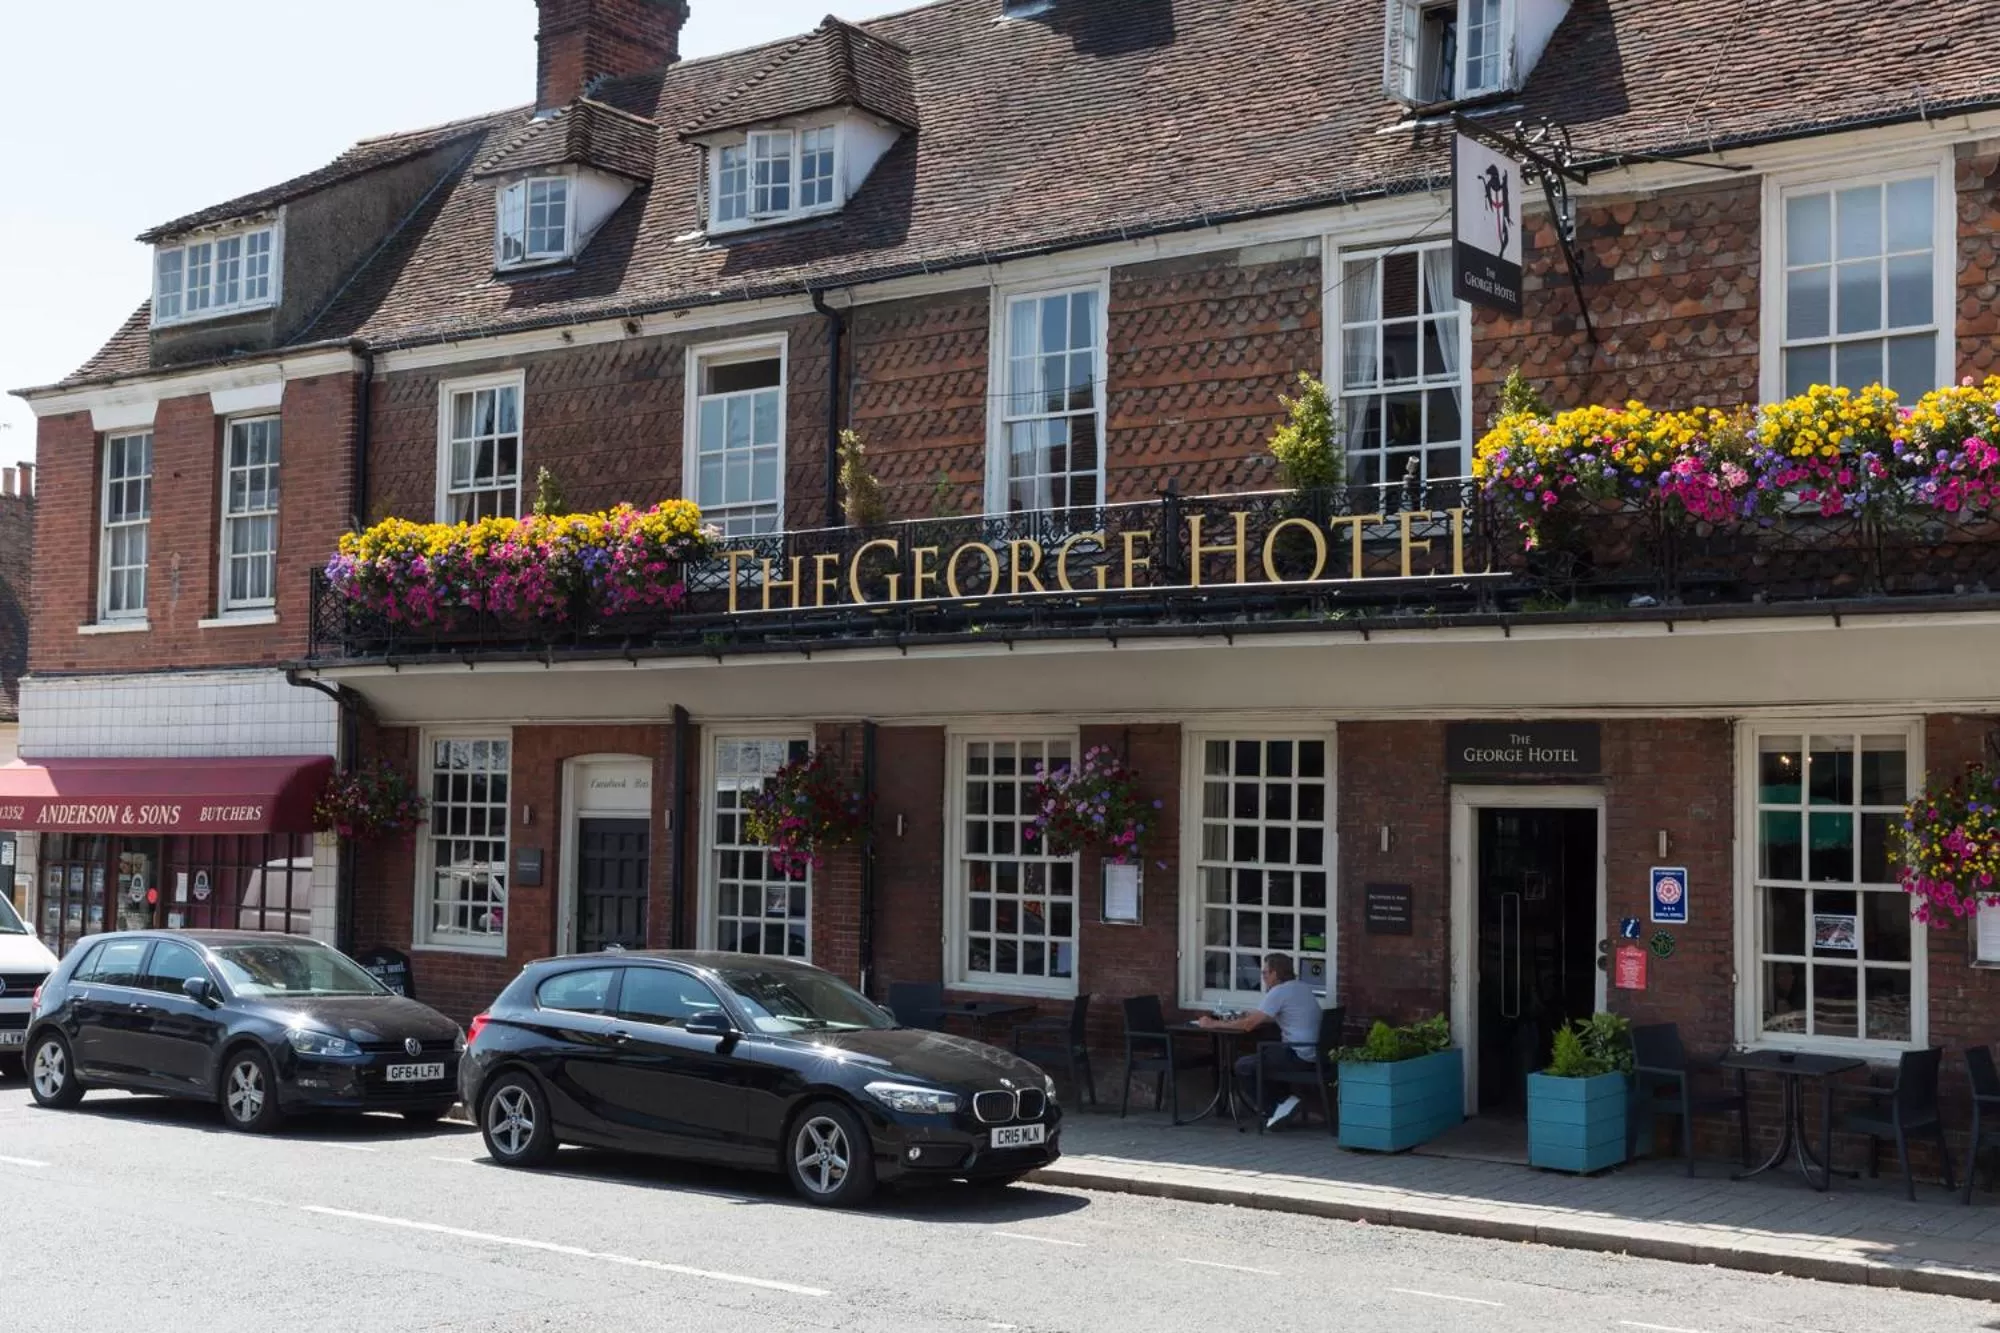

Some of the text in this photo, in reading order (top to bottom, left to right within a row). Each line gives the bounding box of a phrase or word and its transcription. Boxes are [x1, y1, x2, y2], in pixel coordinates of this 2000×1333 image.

[1494, 282, 1517, 304] HOTEL
[850, 530, 1153, 612] GEORGE
[1185, 508, 1494, 588] HOTEL
[1510, 733, 1532, 745] THE
[1463, 747, 1579, 763] GEORGE HOTEL
[36, 804, 119, 824] ANDERSON
[121, 805, 134, 824] &
[138, 804, 182, 825] SONS
[200, 805, 263, 821] BUTCHERS
[391, 1066, 418, 1079] GF64
